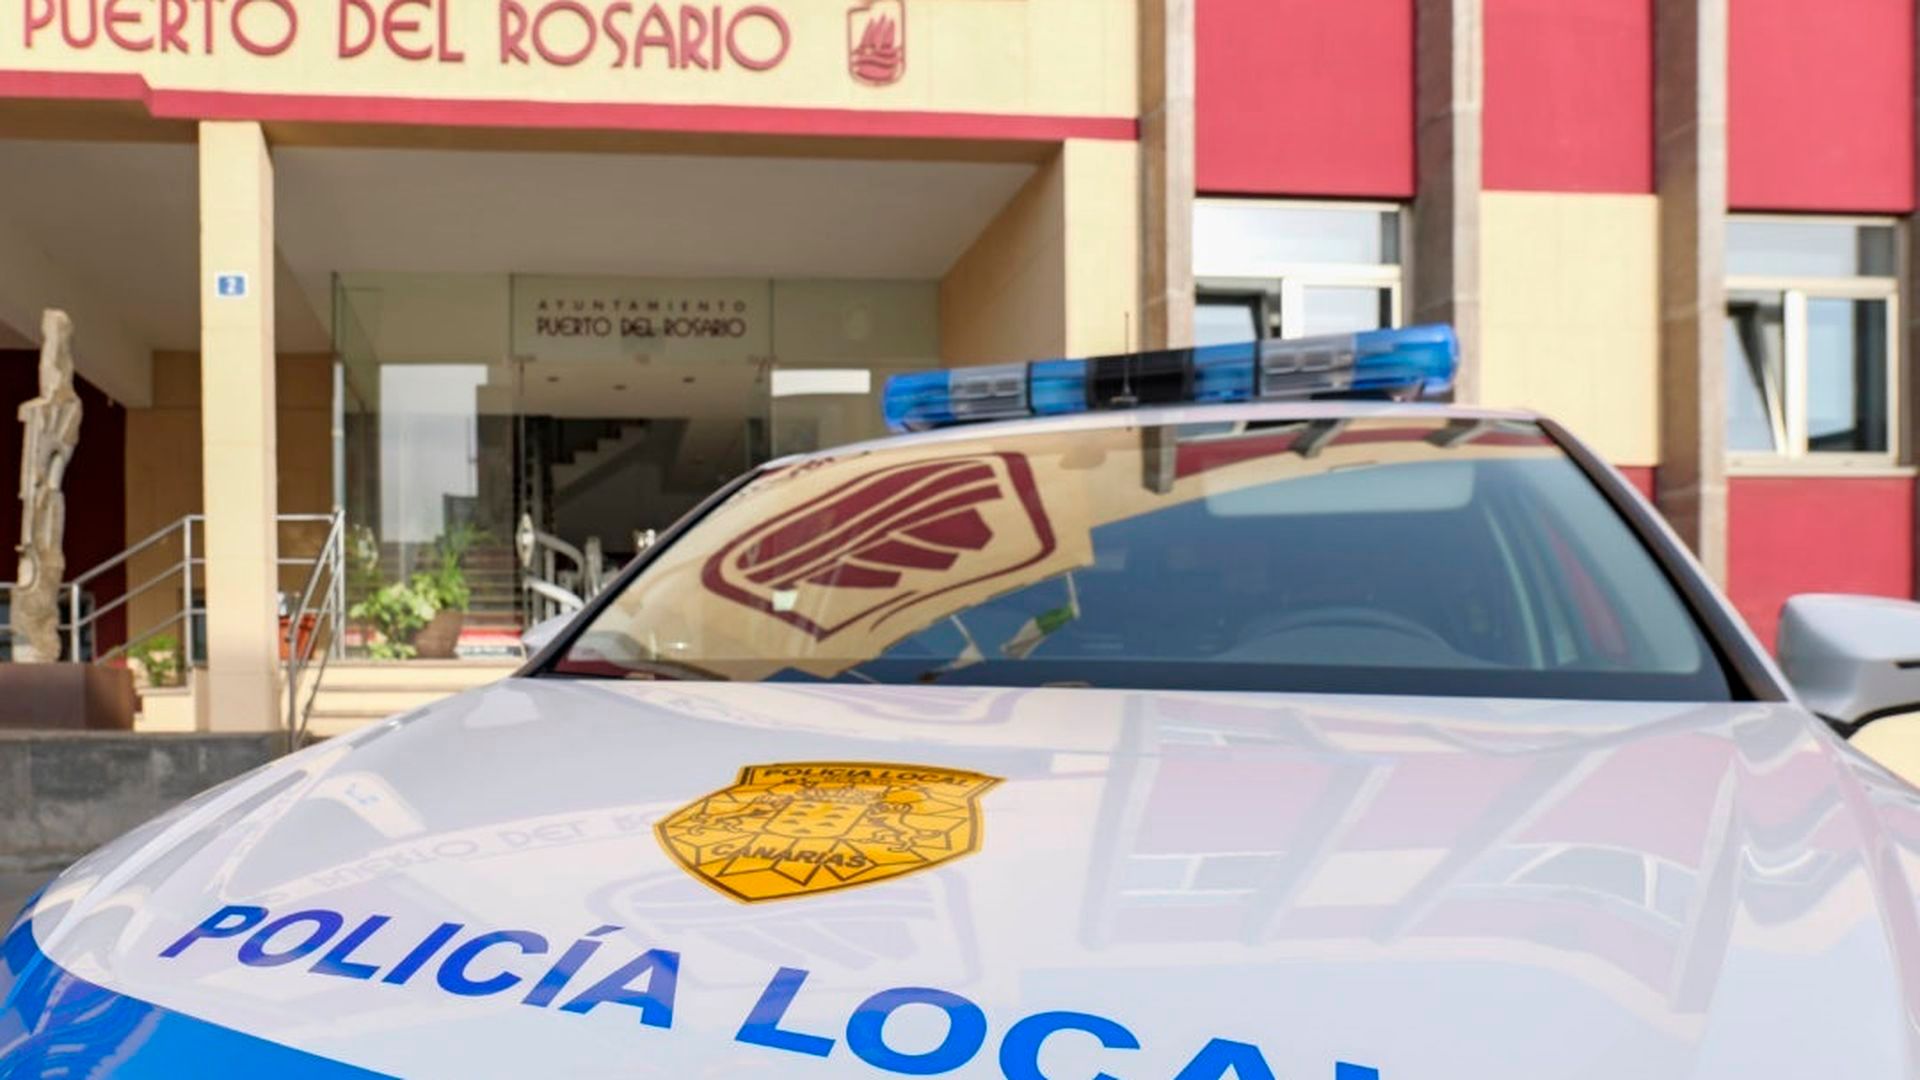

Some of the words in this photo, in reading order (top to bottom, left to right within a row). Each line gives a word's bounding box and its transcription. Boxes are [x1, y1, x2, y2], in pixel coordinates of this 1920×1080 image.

[23, 0, 299, 57] PUERTO
[337, 0, 465, 62] DEL
[499, 2, 791, 72] ROSARIO
[538, 300, 747, 313] AYUNTAMIENTO
[537, 316, 612, 337] PUERTO
[620, 317, 656, 338] DEL
[663, 317, 747, 339] ROSARIO
[880, 770, 970, 788] LOCAL
[711, 843, 866, 868] CANARIAS
[158, 904, 681, 1029] POLICÍA
